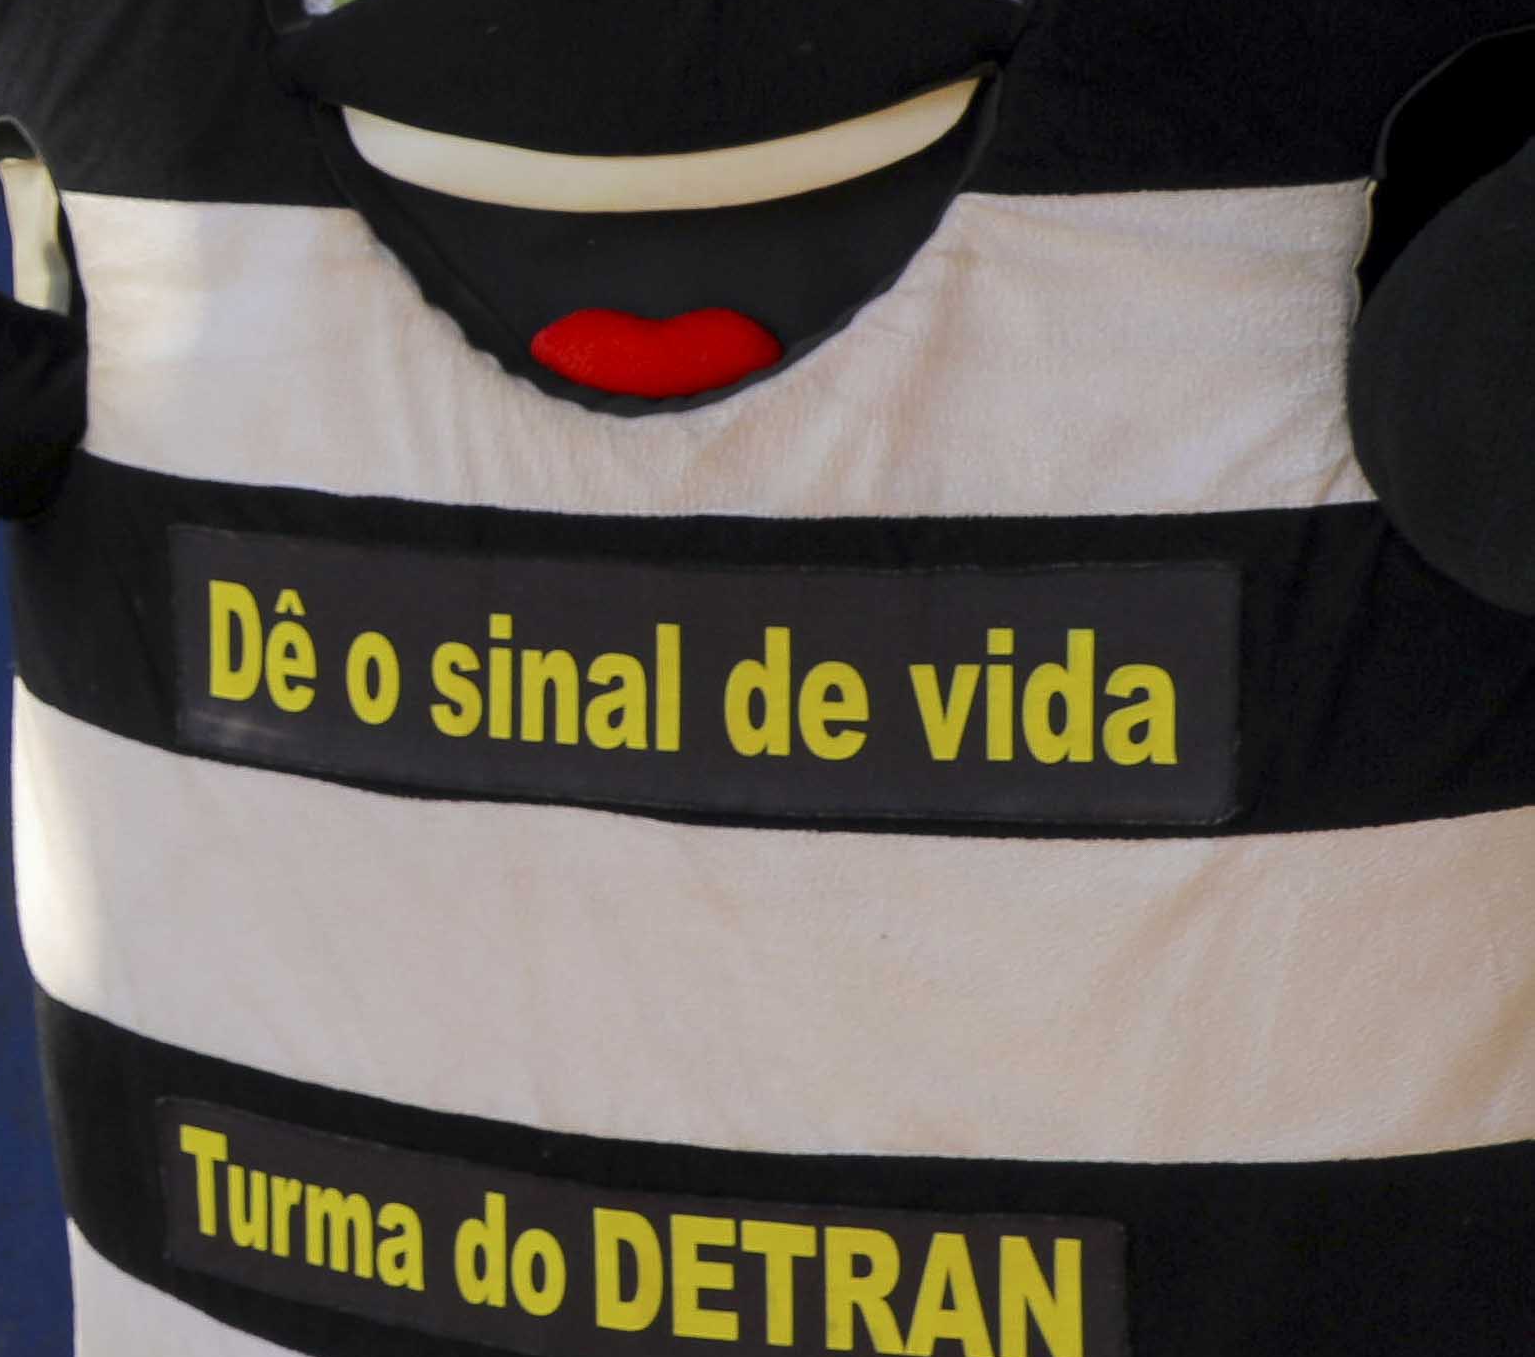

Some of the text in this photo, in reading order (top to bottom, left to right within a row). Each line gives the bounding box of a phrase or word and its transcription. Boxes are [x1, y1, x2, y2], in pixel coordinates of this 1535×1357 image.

[209, 580, 1177, 765] Dê o sinal de vida
[180, 1125, 424, 1291] Turma
[455, 1192, 566, 1316] do
